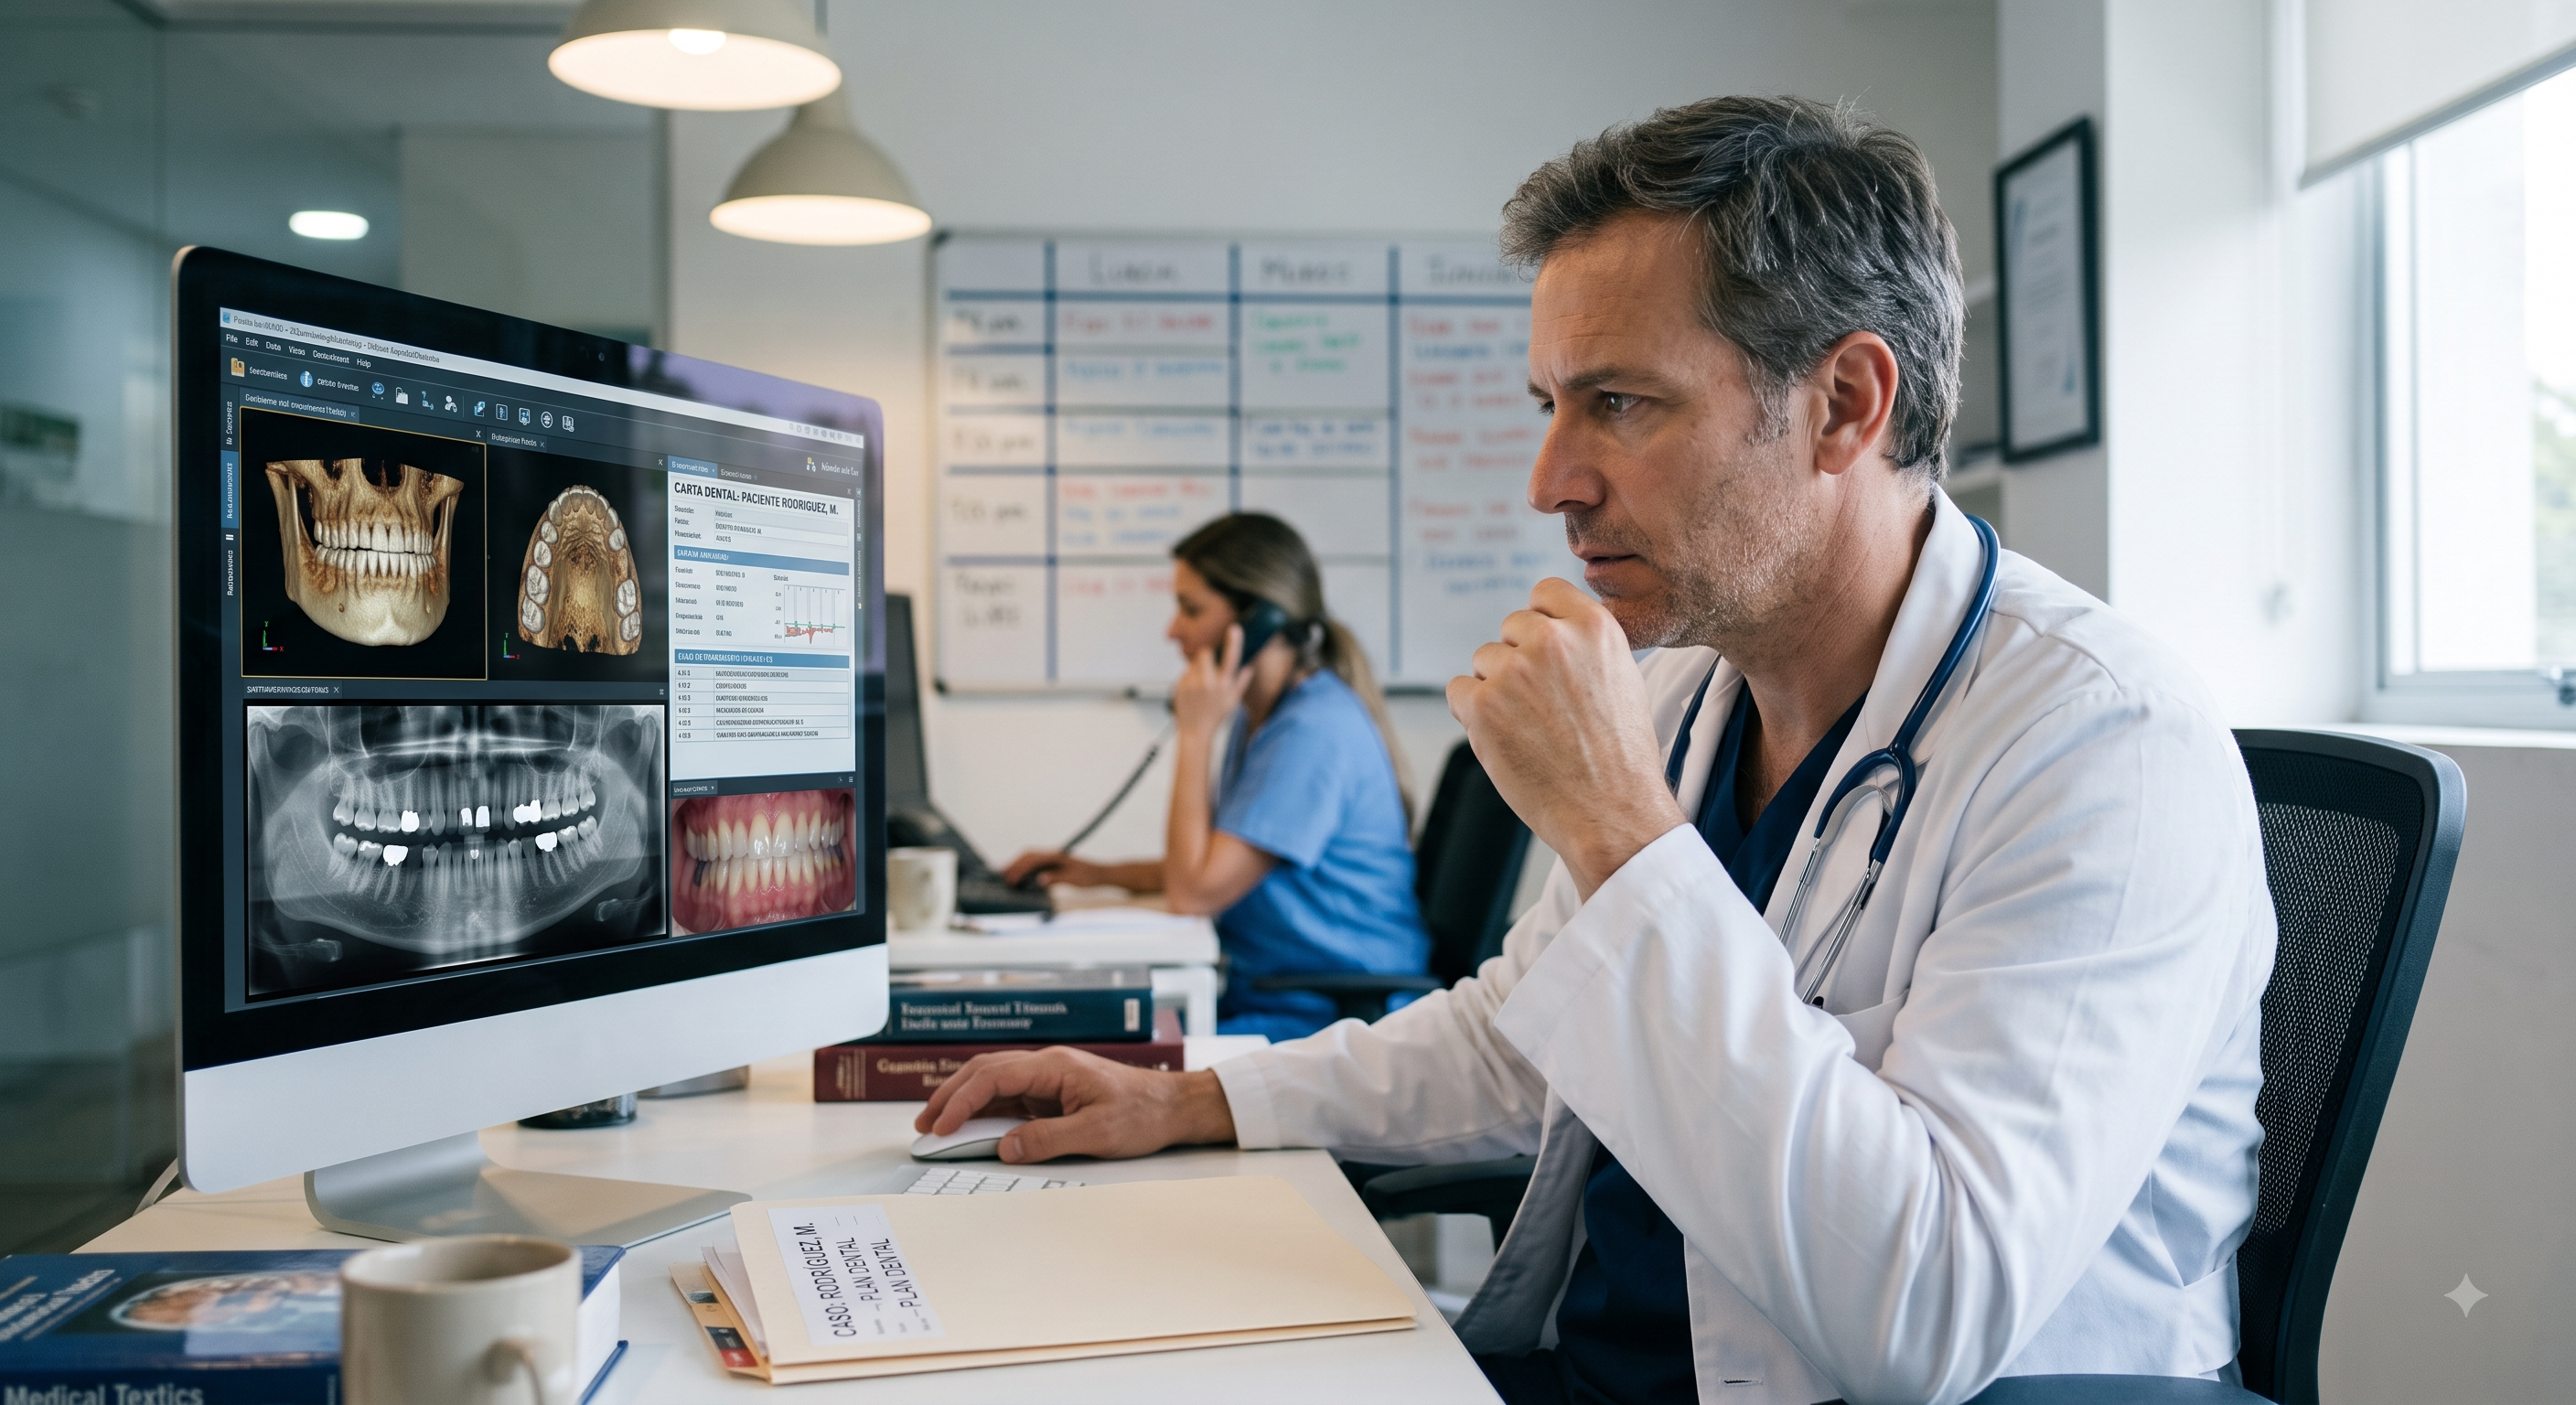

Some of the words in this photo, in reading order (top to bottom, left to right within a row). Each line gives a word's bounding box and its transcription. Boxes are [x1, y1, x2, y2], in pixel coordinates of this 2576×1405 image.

[357, 358, 371, 369] Help
[674, 482, 703, 497] CARTA
[704, 486, 740, 501] DENTAL:
[741, 491, 780, 508] PACIENTE
[830, 504, 839, 515] M.
[793, 1222, 817, 1236] M.
[799, 1237, 843, 1300] RODRÍGUEZ,
[836, 1237, 870, 1274] DENTAL
[870, 1238, 907, 1277] DENTAL
[852, 1276, 883, 1301] PLAN
[888, 1280, 922, 1308] PLAN
[824, 1303, 857, 1337] CASO:
[3, 1383, 106, 1405] Medical
[113, 1382, 204, 1405] Textics
